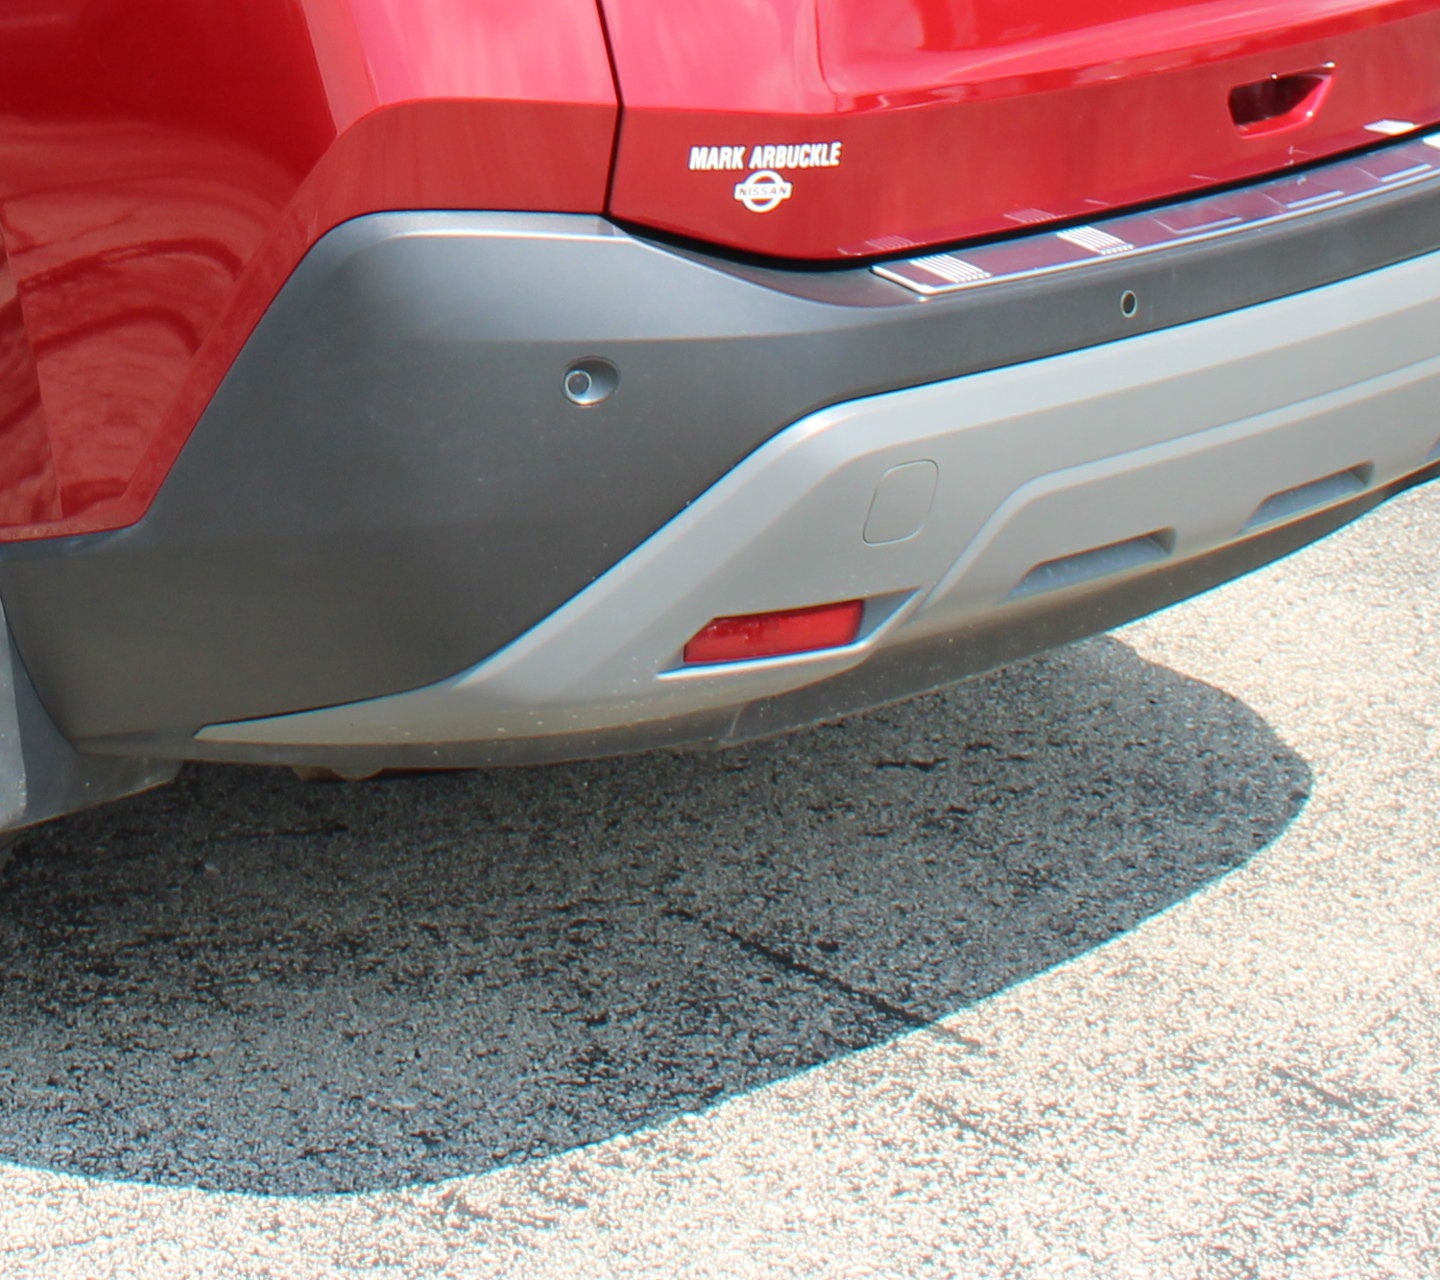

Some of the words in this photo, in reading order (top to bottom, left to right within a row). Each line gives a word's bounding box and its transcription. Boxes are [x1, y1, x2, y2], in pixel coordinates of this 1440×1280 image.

[689, 145, 747, 171] MARK
[748, 141, 843, 170] ARBUCKLE
[738, 185, 789, 197] NISSAN
